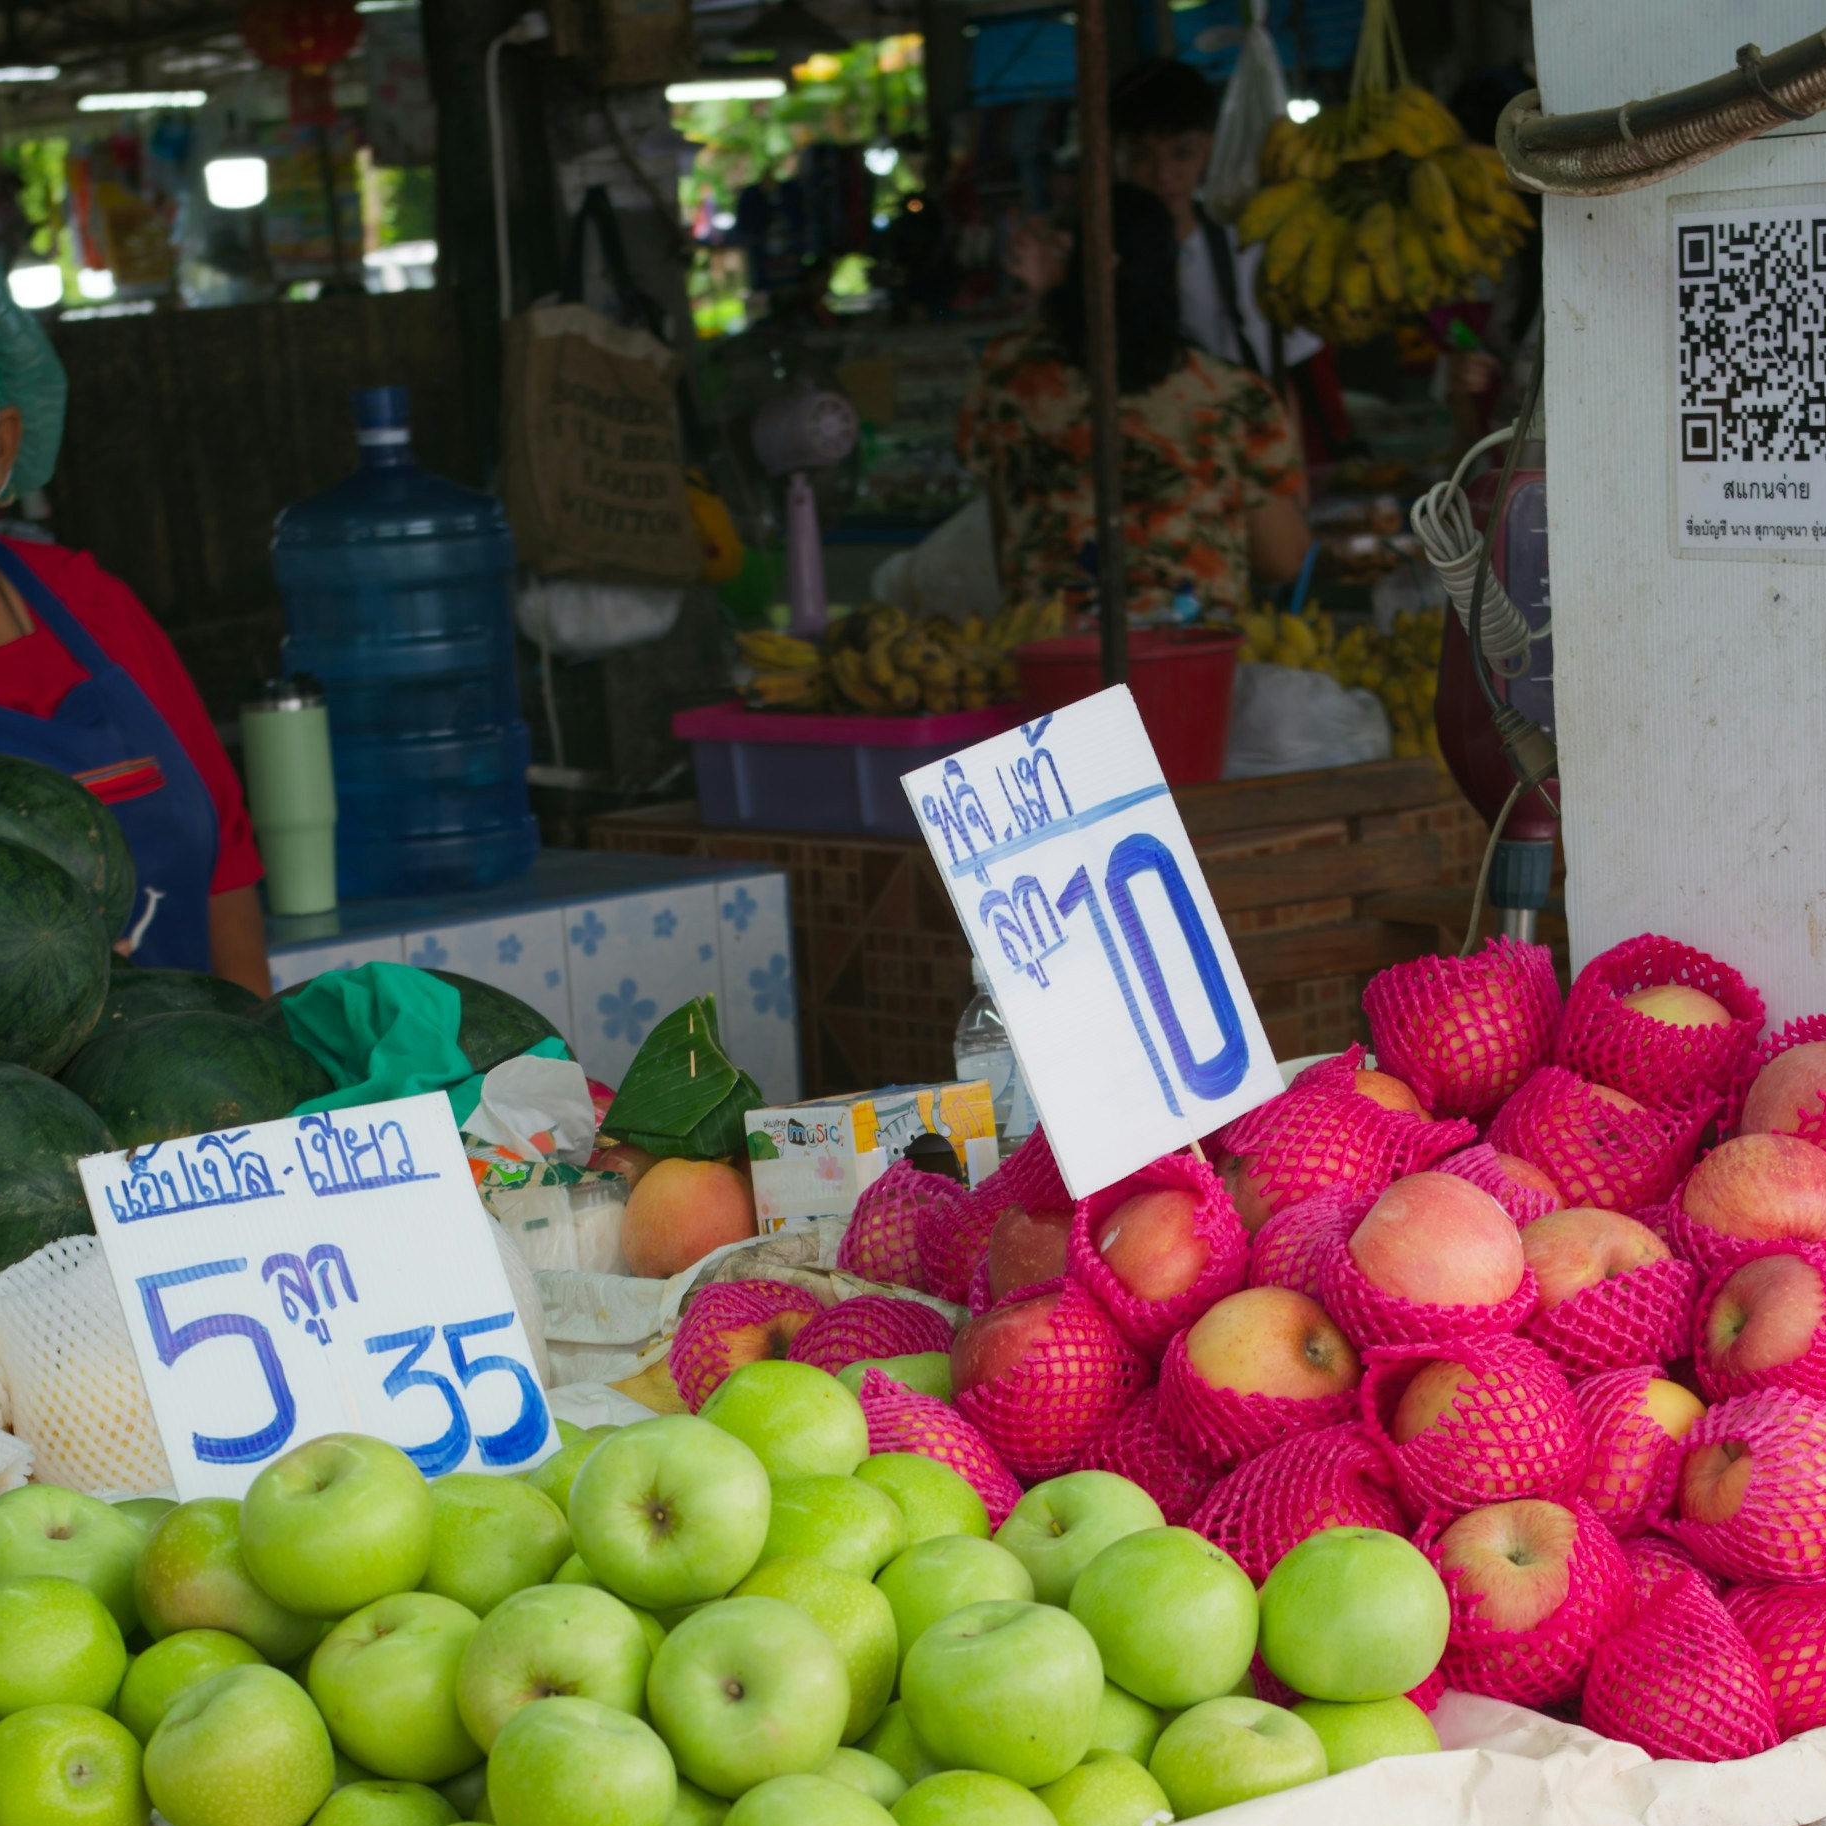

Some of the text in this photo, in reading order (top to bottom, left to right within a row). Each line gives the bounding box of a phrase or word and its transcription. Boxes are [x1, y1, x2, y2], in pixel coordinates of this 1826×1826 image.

[1686, 515, 1727, 540] ชื่อบัญชี
[1731, 525, 1751, 537] นาง
[1723, 473, 1811, 500] สแกนจ่าย
[979, 834, 1250, 1117] ลูก 10
[294, 1111, 417, 1194] เขียว
[135, 1243, 550, 1479] 5 ลูก 35
